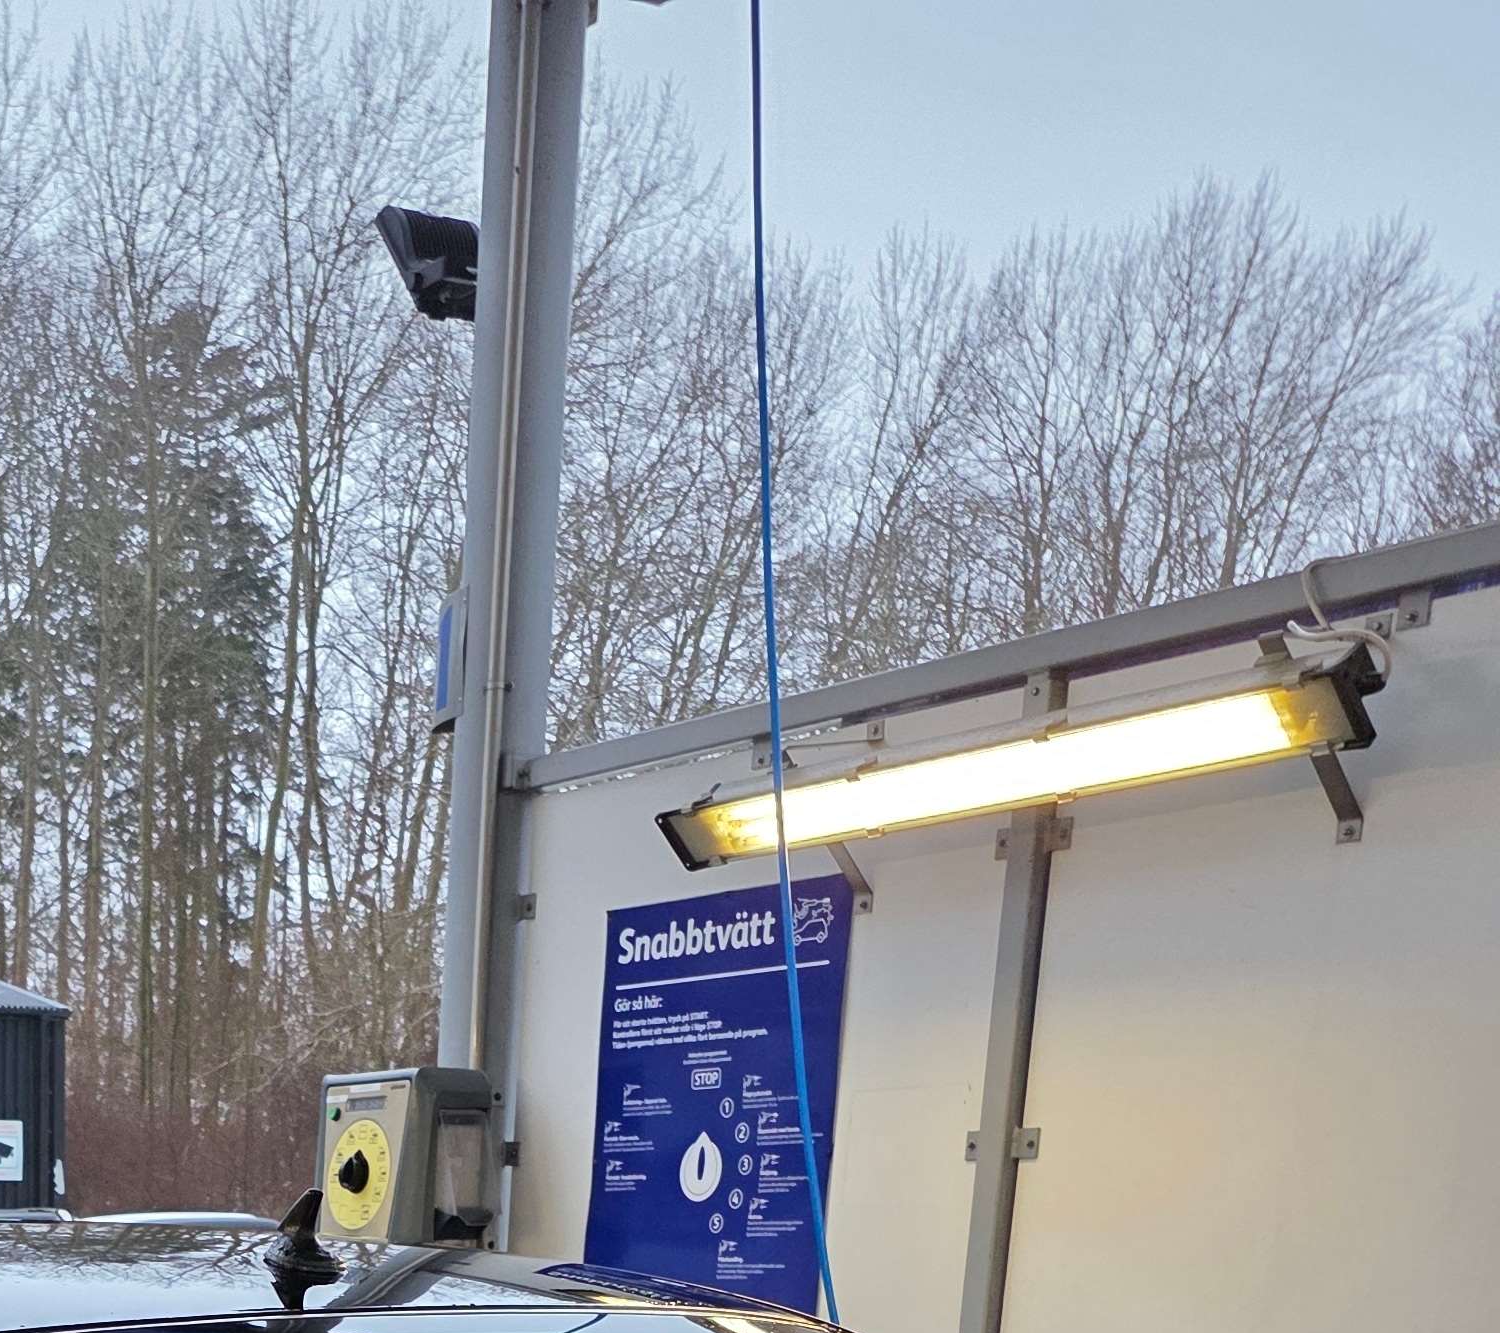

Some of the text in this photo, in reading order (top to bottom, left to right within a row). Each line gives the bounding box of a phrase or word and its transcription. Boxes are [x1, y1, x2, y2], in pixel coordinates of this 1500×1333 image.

[617, 911, 776, 965] Snabbtvätt
[614, 998, 631, 1012] Gör
[632, 995, 643, 1010] så
[694, 1072, 719, 1086] STOP
